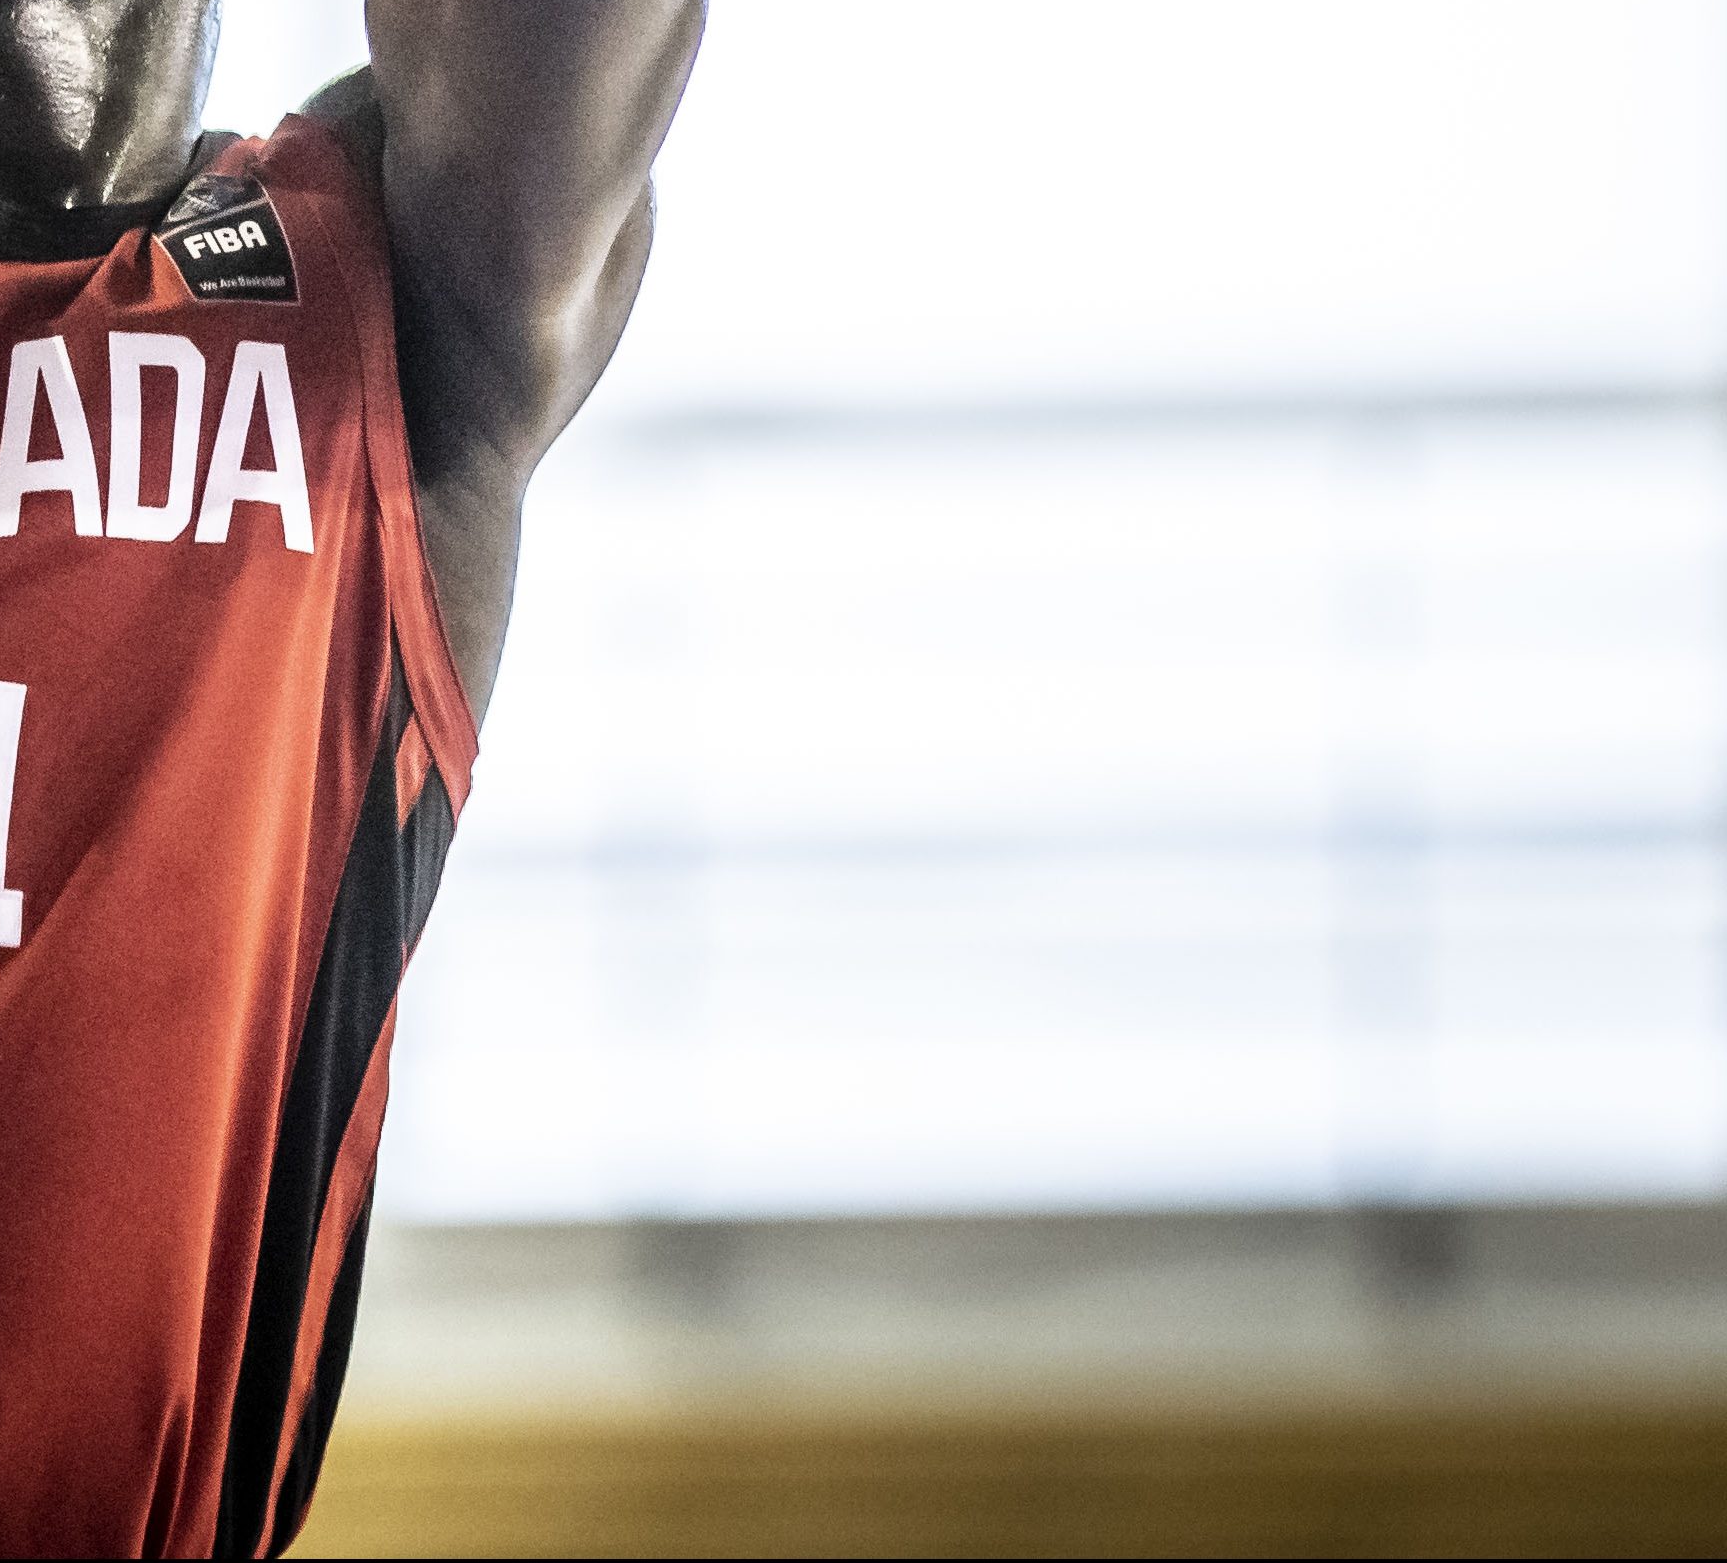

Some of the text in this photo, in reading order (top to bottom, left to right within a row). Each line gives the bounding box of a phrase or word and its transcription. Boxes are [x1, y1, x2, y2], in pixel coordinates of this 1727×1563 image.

[183, 220, 268, 260] FIBA
[199, 280, 218, 292] We
[219, 277, 238, 289] Are
